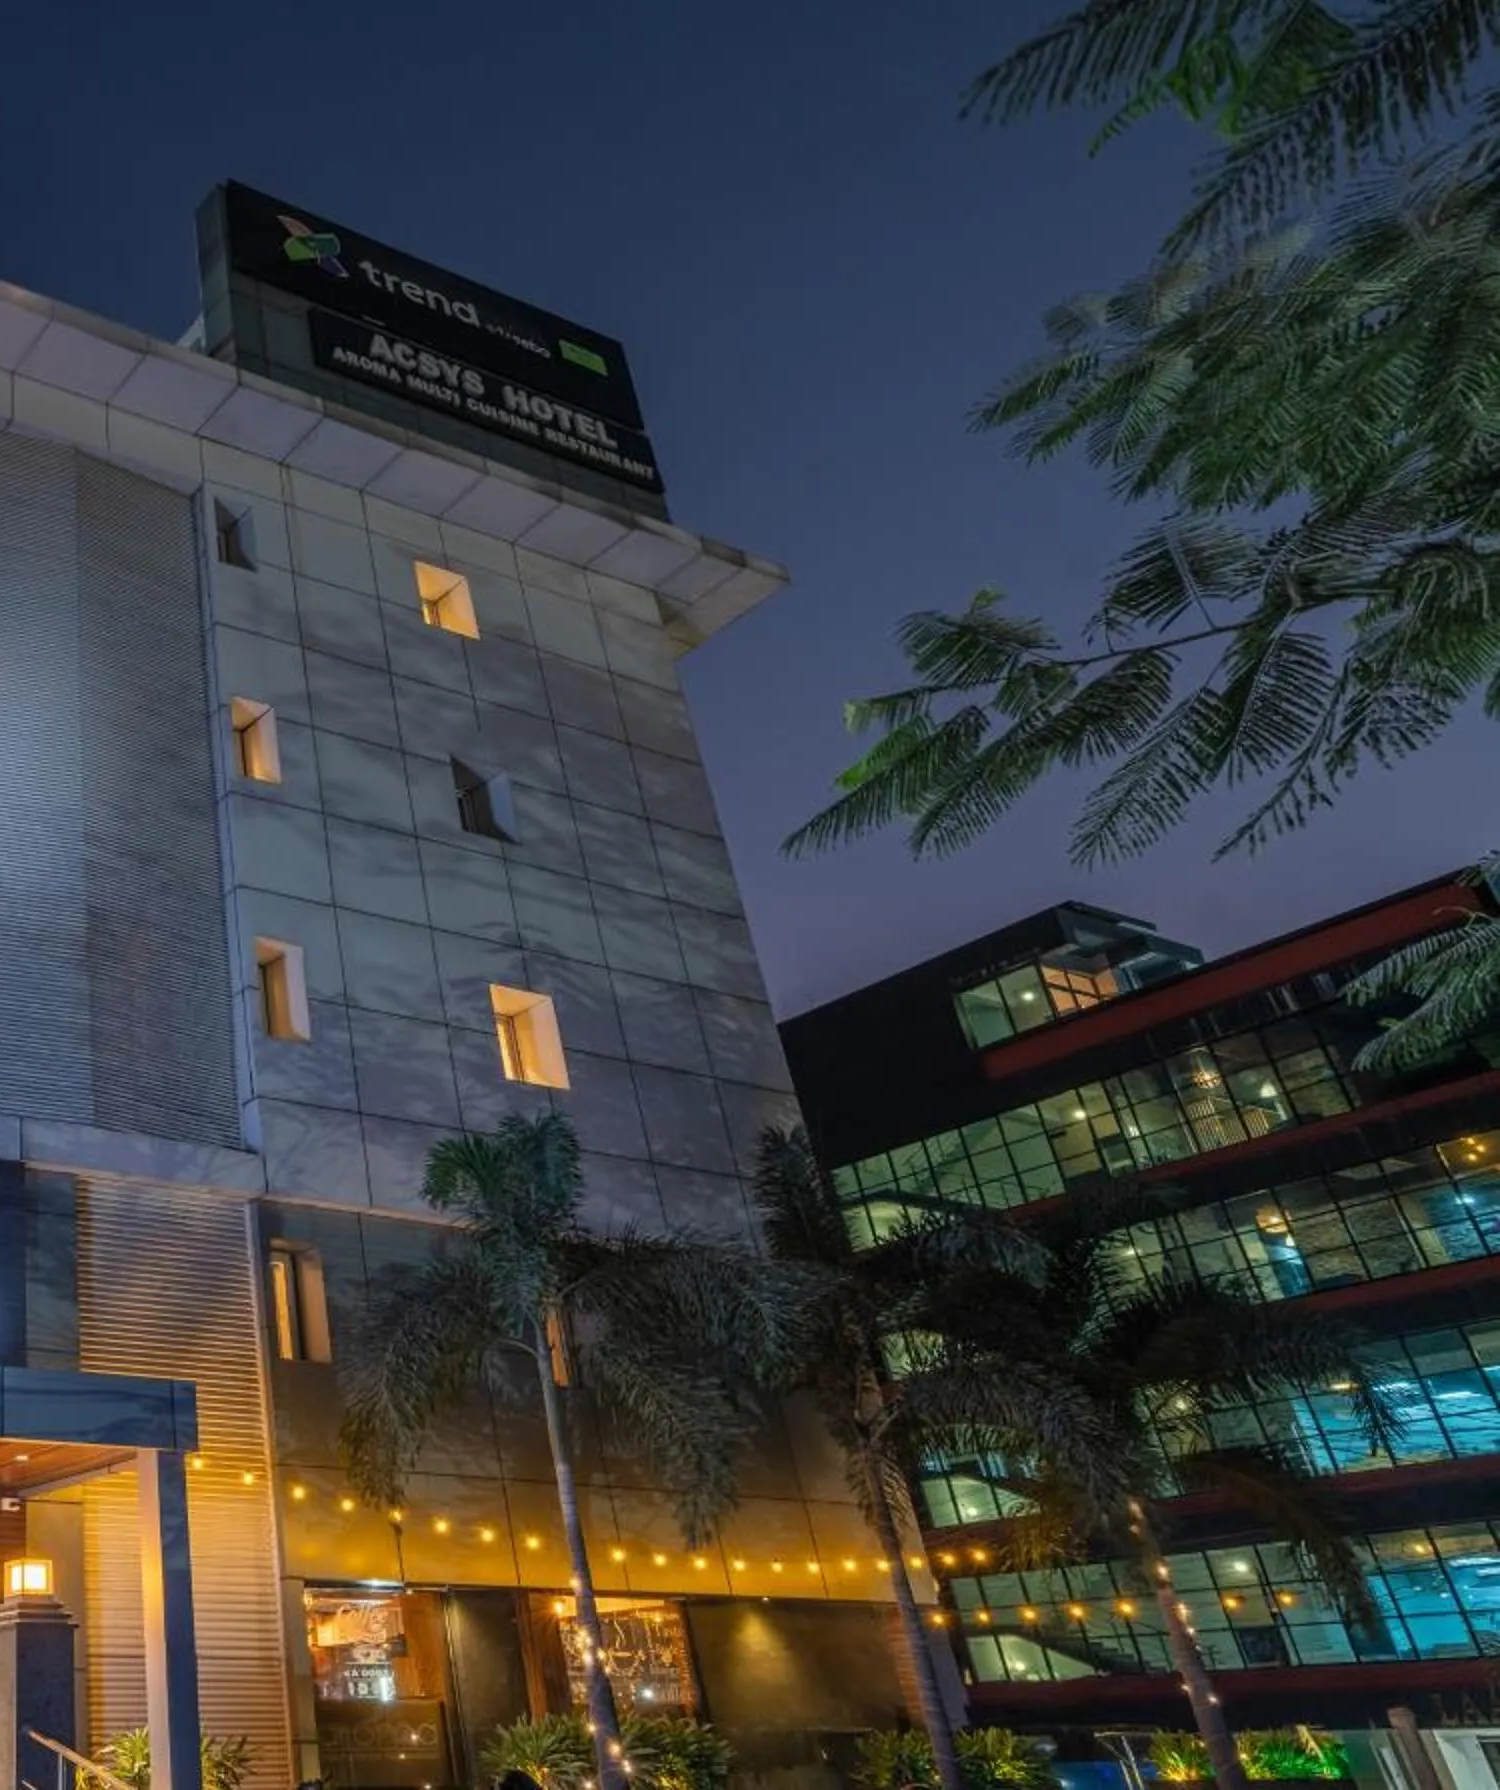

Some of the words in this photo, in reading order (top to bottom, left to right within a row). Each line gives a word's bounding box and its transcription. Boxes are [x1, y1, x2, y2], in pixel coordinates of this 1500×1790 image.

[358, 260, 481, 328] trend
[333, 347, 402, 383] AROMA
[406, 374, 460, 407] MULTI
[466, 397, 540, 436] CUISINE
[370, 334, 485, 396] ACSYS
[502, 385, 618, 448] HOTEL
